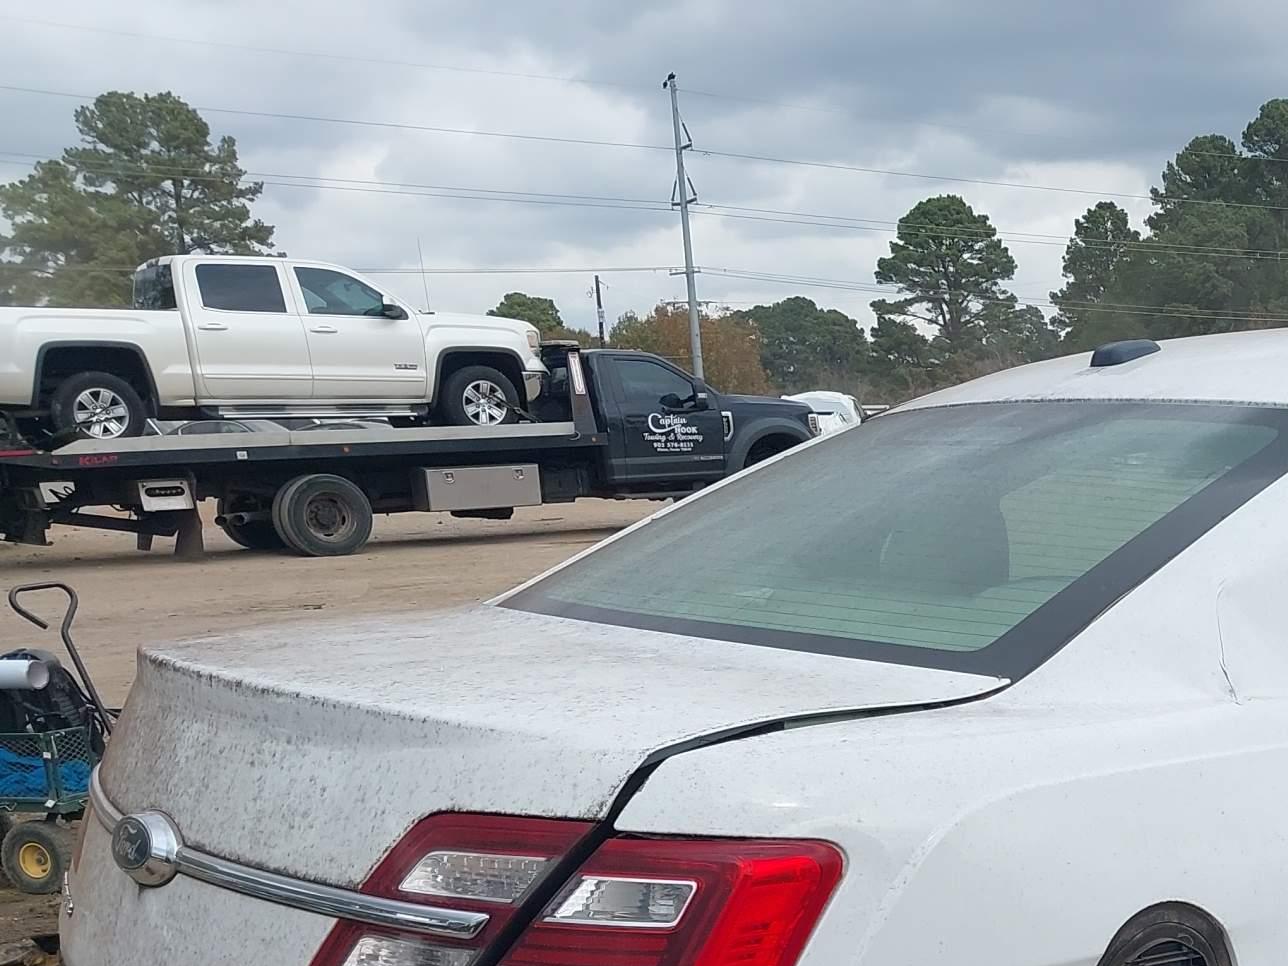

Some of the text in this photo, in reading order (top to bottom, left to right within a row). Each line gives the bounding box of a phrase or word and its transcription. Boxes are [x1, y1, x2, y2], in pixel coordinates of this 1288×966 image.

[648, 412, 688, 433] Captain
[675, 425, 698, 434] HOOK
[643, 432, 704, 443] Towing & Recovery
